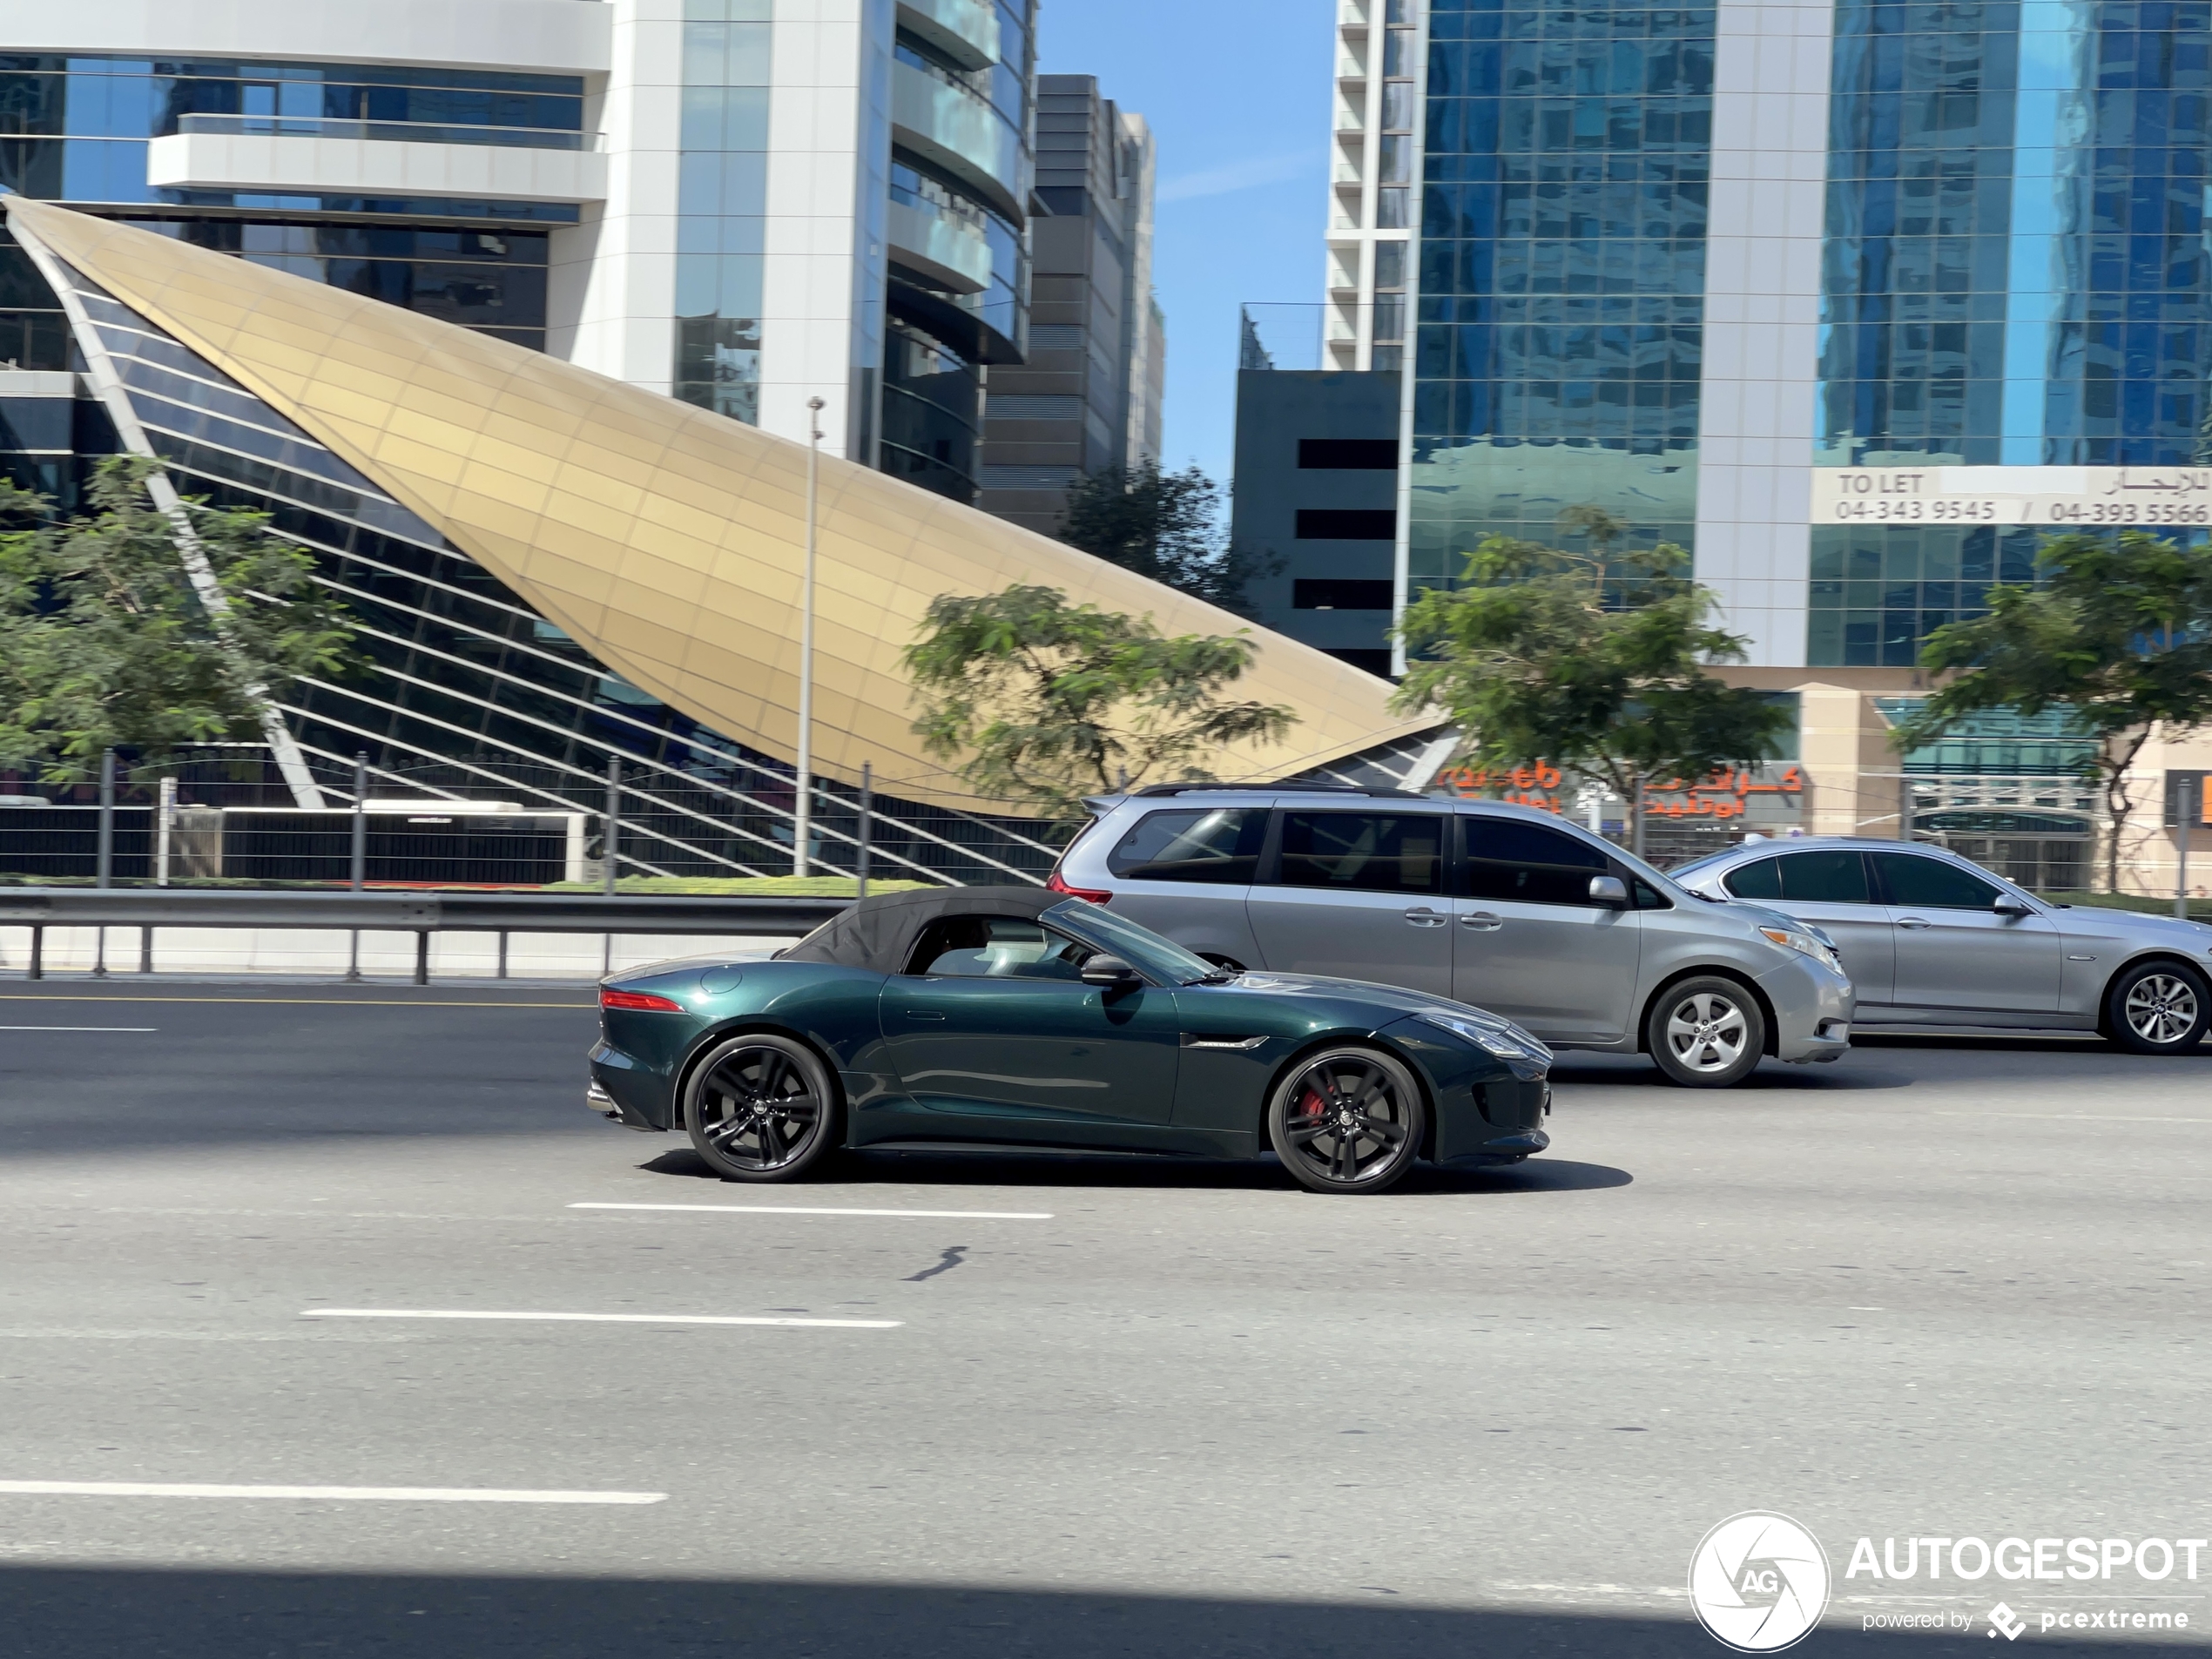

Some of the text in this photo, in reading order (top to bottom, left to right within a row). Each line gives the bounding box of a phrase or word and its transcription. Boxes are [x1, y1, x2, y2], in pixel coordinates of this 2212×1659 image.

[1838, 474, 1925, 494] TO LET
[1835, 501, 1923, 520] 04-343
[1932, 501, 1995, 520] 9545
[2049, 502, 2138, 523] 04-393
[2144, 503, 2210, 523] 5566
